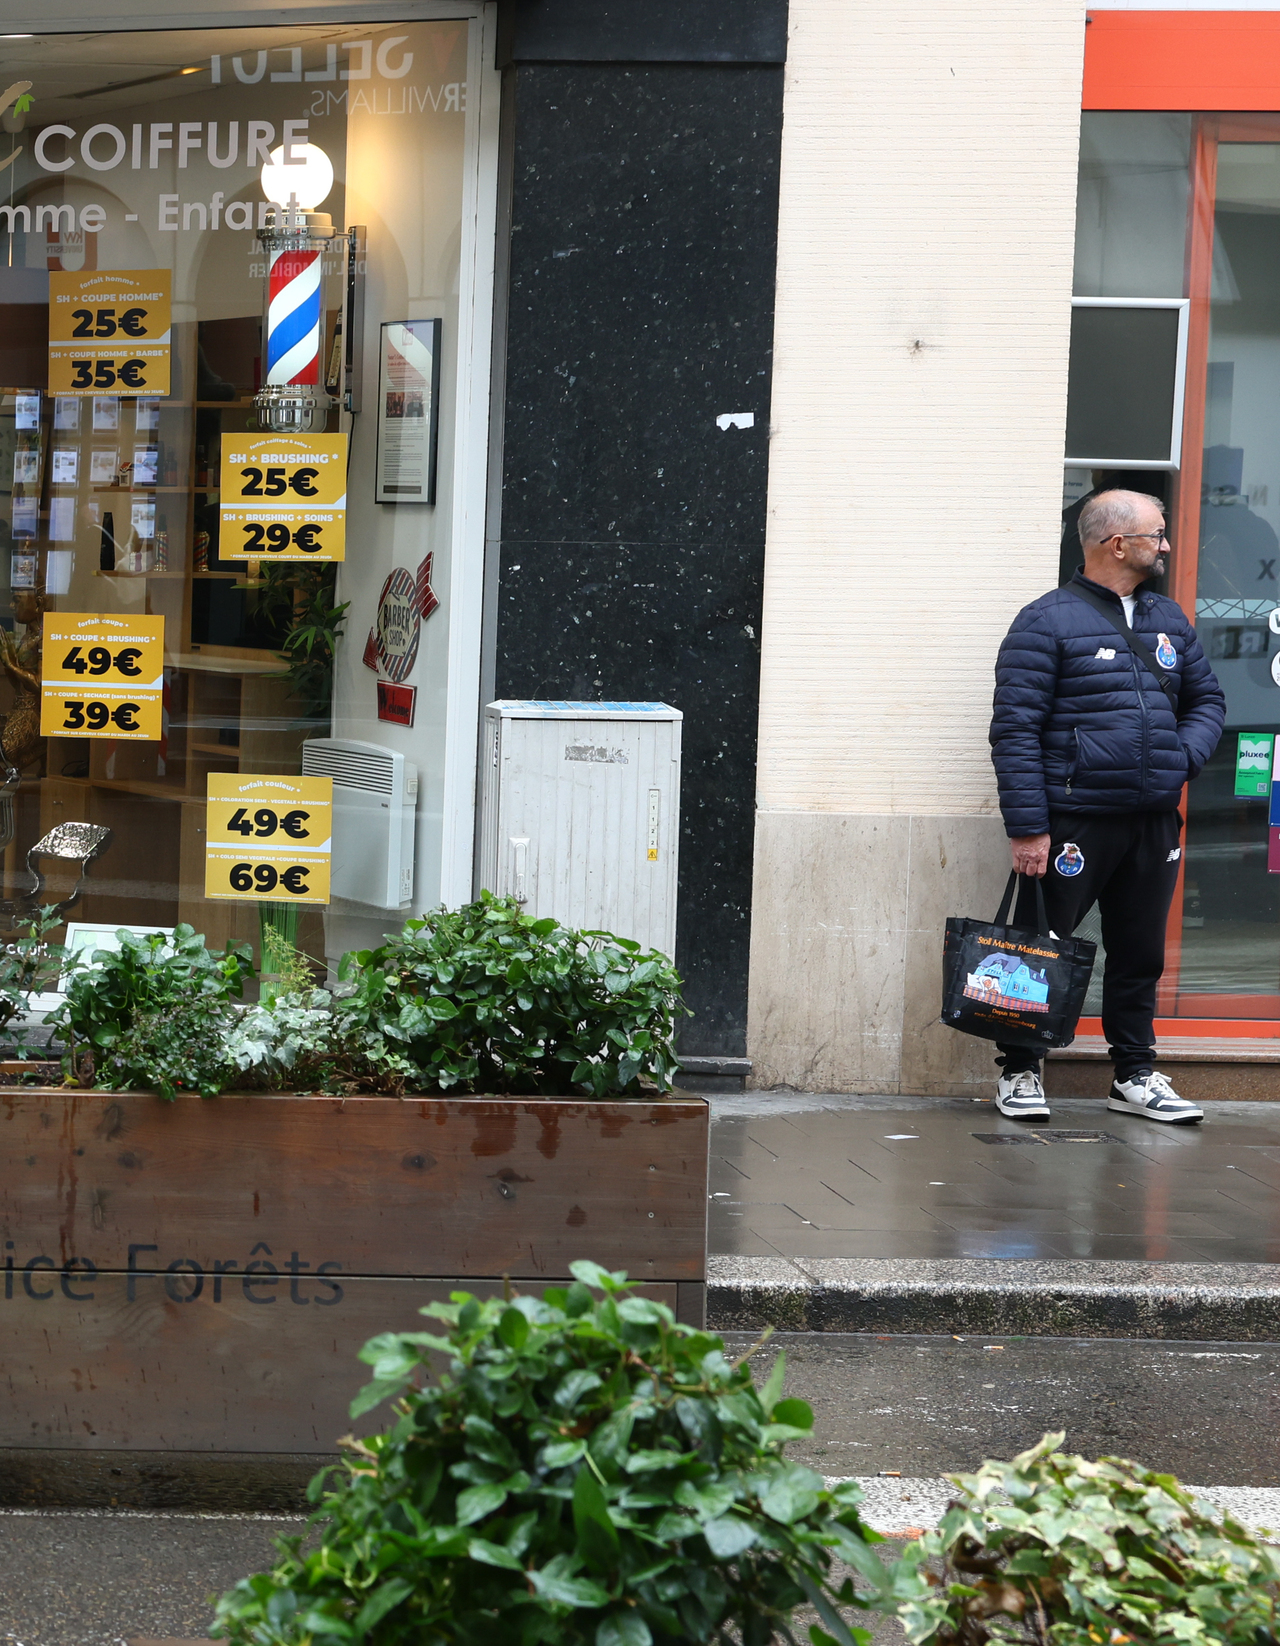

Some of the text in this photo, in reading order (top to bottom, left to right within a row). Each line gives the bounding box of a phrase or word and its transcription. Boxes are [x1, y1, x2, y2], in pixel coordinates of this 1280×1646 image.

[34, 119, 309, 172] COIFFURE
[158, 191, 300, 231] Enfant
[80, 276, 134, 289] forfait homme
[56, 295, 70, 303] SH
[81, 294, 116, 303] COUPE
[71, 308, 148, 338] 25€
[98, 350, 128, 358] HOMME
[71, 359, 147, 388] 35€
[250, 441, 266, 450] forfait
[229, 454, 329, 464] SH BRUSHING
[240, 467, 319, 497] 25€
[304, 514, 333, 522] SOINS
[242, 523, 323, 553] 29€
[78, 618, 124, 628] forfait coupe
[383, 604, 410, 633] BARBER
[70, 634, 98, 642] COUPE
[107, 635, 150, 643] BRUSHING
[389, 628, 403, 646] SHOP
[62, 647, 143, 677] 49€
[62, 701, 141, 731] 39€
[1239, 750, 1269, 761] pluxee
[238, 780, 295, 792] forfait couleur
[227, 808, 310, 839] 49€
[229, 863, 310, 894] 69€
[977, 936, 1060, 959] Stoll Maître Matelassier
[127, 1241, 345, 1306] Forêts
